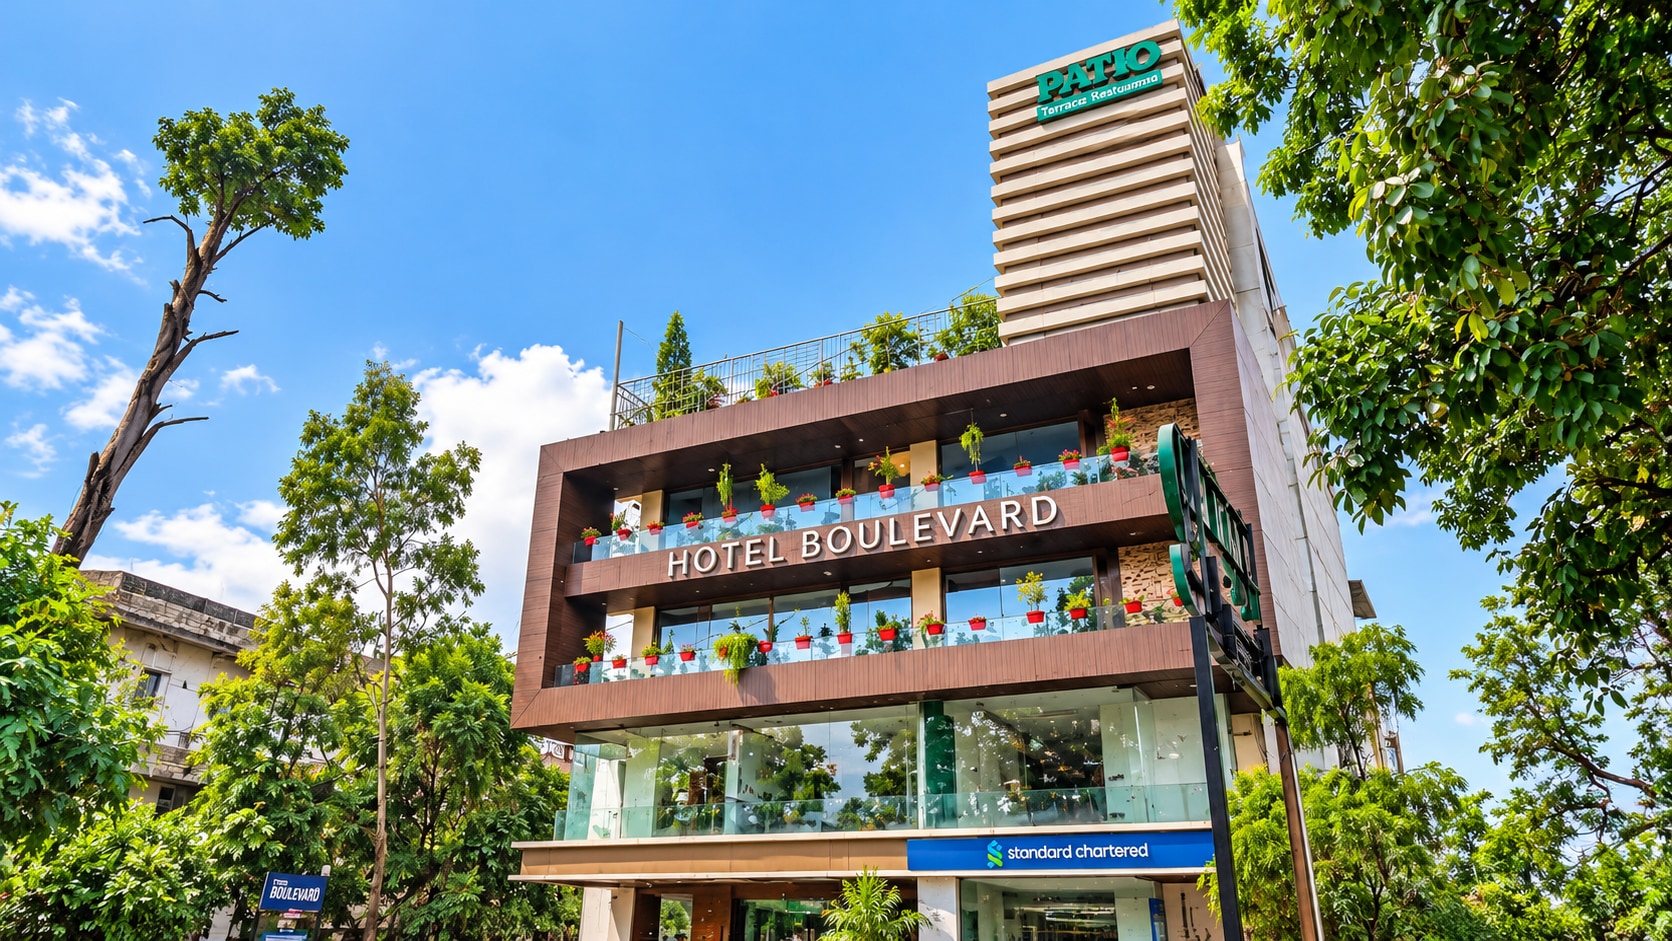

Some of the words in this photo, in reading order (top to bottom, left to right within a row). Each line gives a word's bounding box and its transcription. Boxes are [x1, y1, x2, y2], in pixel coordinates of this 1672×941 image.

[1036, 40, 1161, 104] PATIO
[668, 536, 785, 577] HOTEL
[801, 496, 1059, 558] BOULEVARD
[1008, 844, 1072, 859] standard
[1075, 842, 1148, 858] chartered
[270, 886, 320, 902] BOULEVARD
